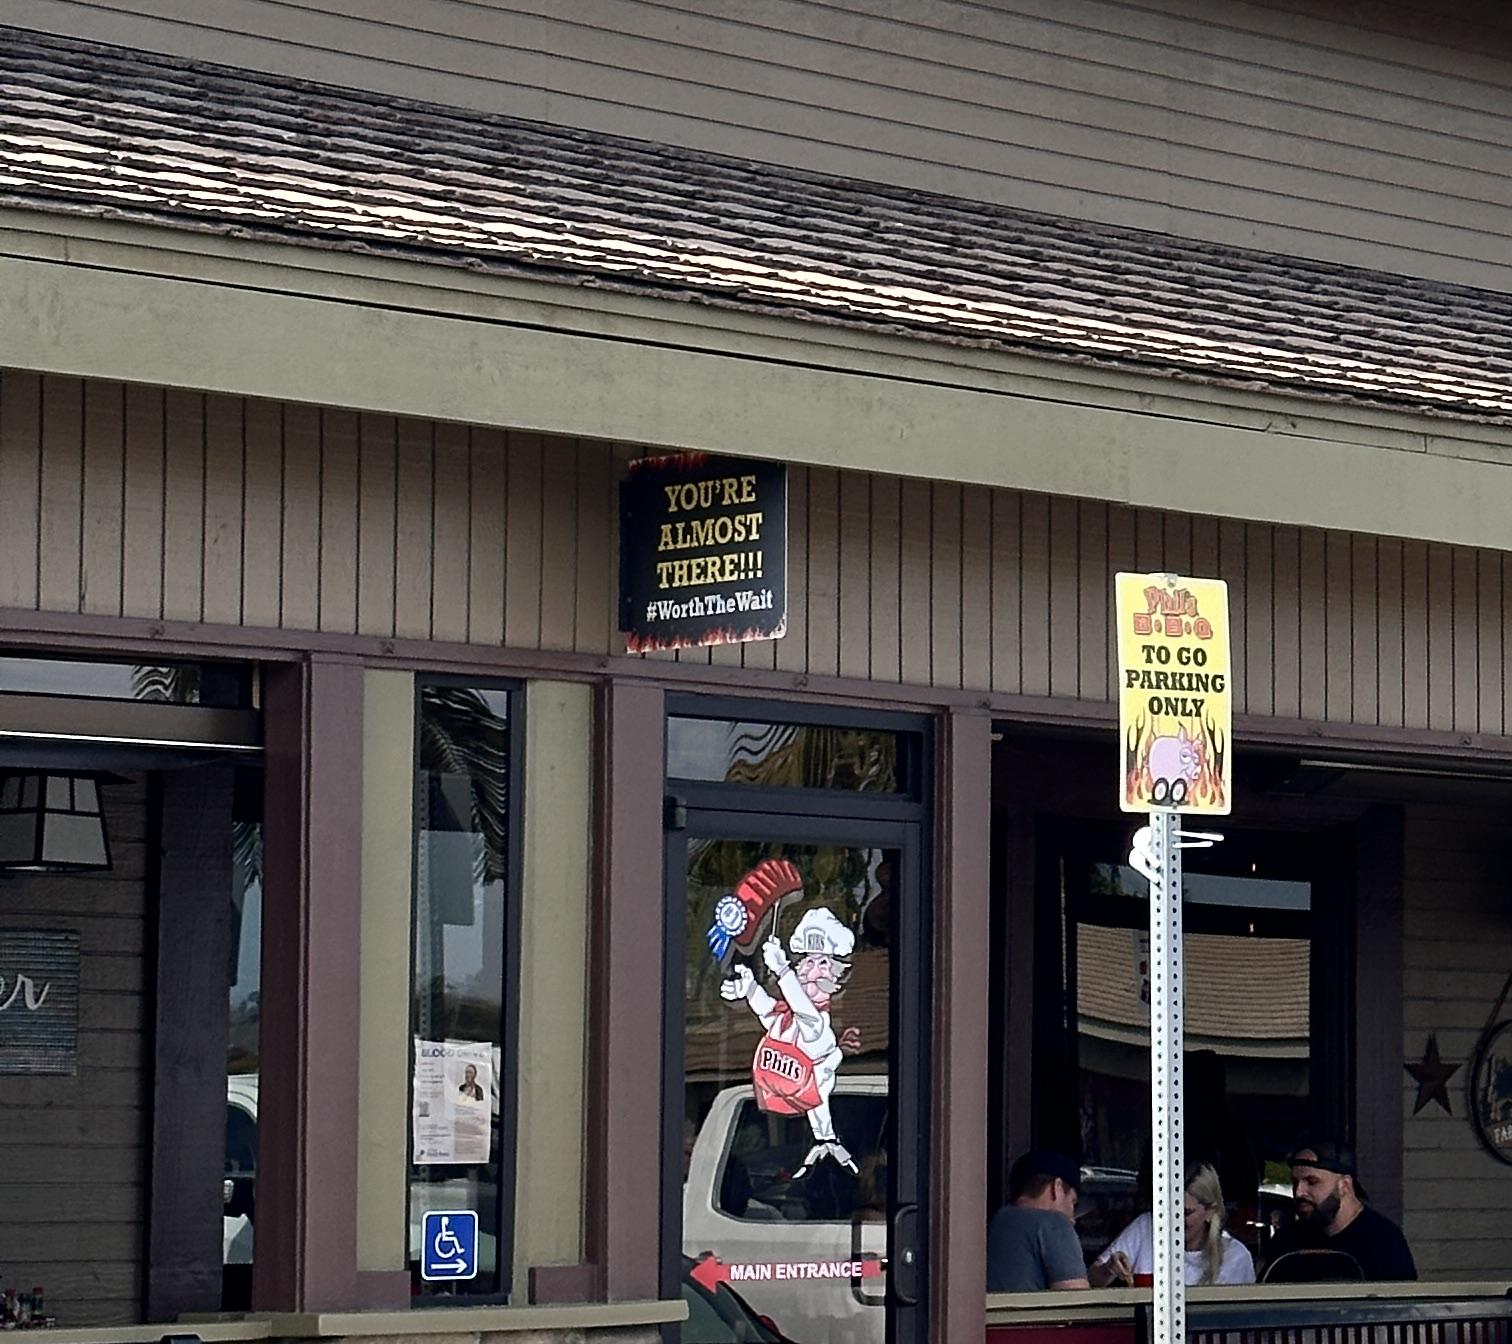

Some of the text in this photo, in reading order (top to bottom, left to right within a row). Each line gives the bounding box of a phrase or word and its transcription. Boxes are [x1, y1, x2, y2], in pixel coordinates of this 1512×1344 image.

[664, 475, 757, 512] YOU'RE
[657, 513, 763, 551] ALMOST
[656, 551, 763, 589] THERE!!!
[646, 589, 773, 622] #WorthTheWait
[1141, 644, 1207, 667] TO GO
[1125, 669, 1225, 693] PARKING
[1148, 696, 1205, 717] ONLY
[763, 1050, 800, 1079] Phils
[730, 1261, 862, 1280] MAIN ENTRANCE
